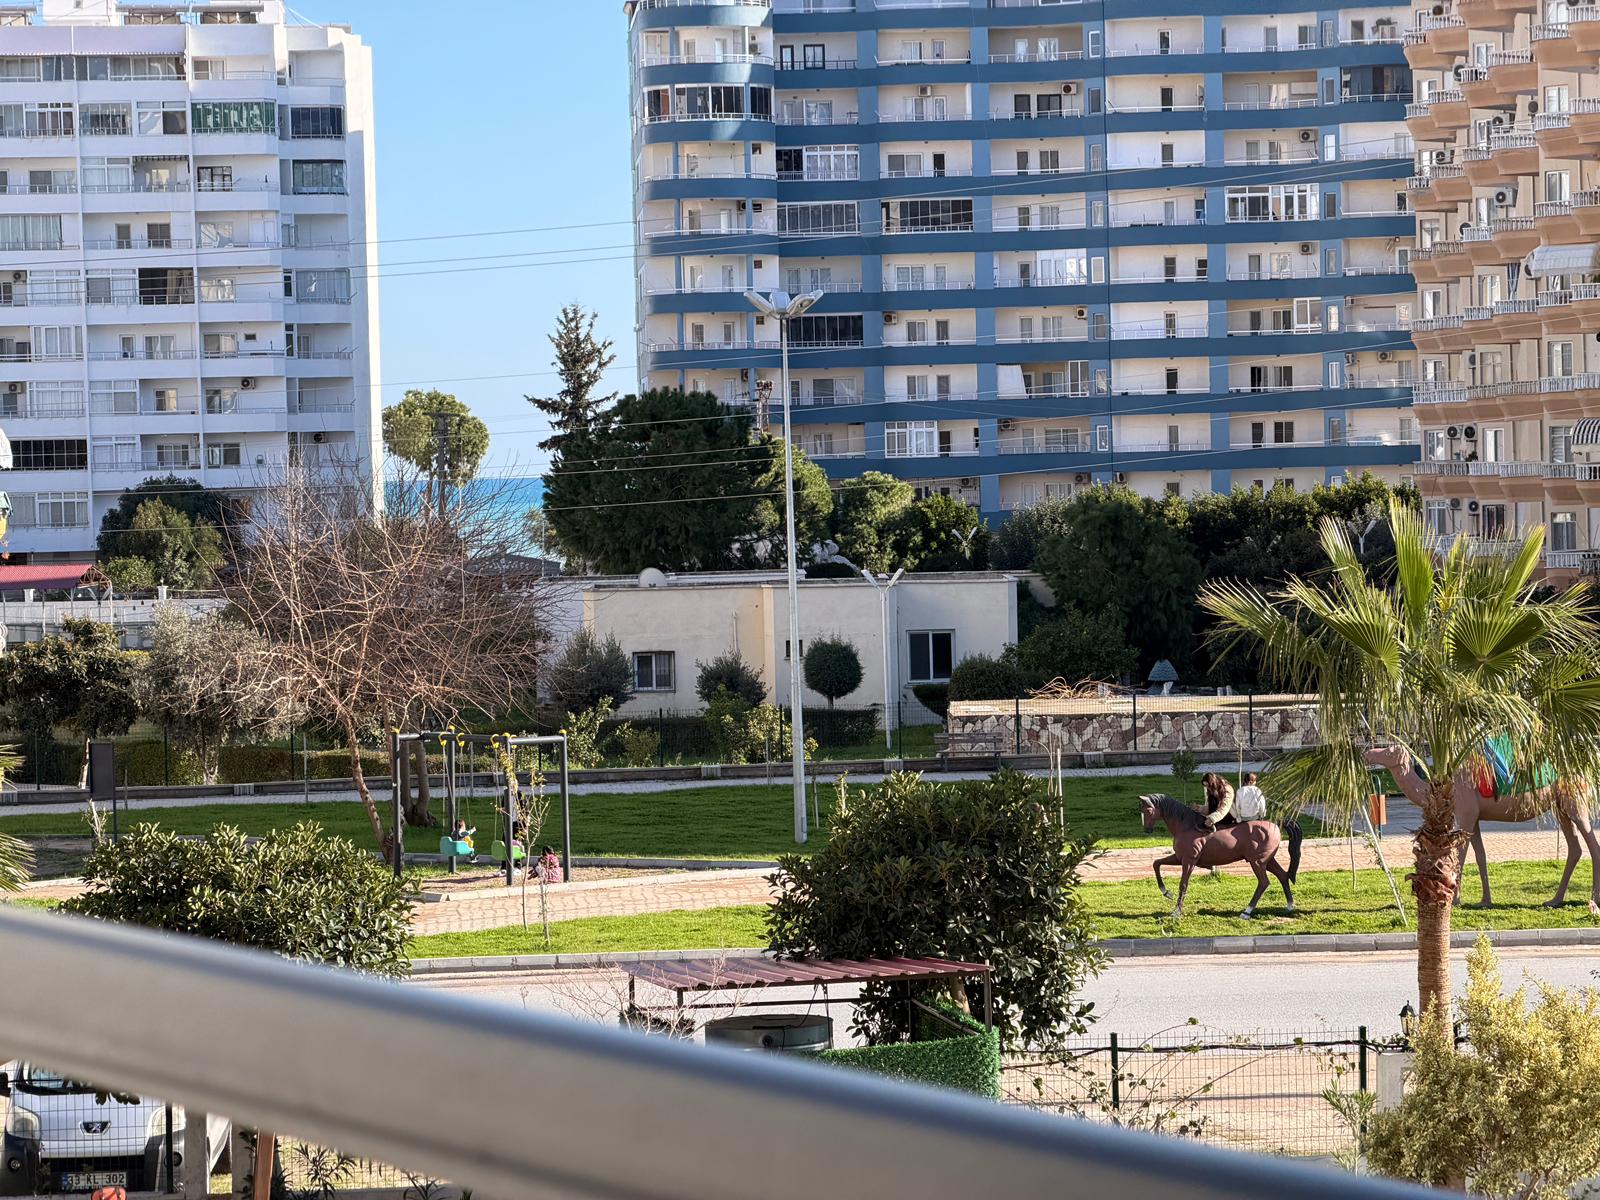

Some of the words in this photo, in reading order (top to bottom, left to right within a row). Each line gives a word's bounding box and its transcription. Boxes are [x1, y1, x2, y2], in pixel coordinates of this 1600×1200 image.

[68, 1175, 81, 1185] 33
[86, 1174, 99, 1185] KL
[105, 1174, 125, 1184] 302
